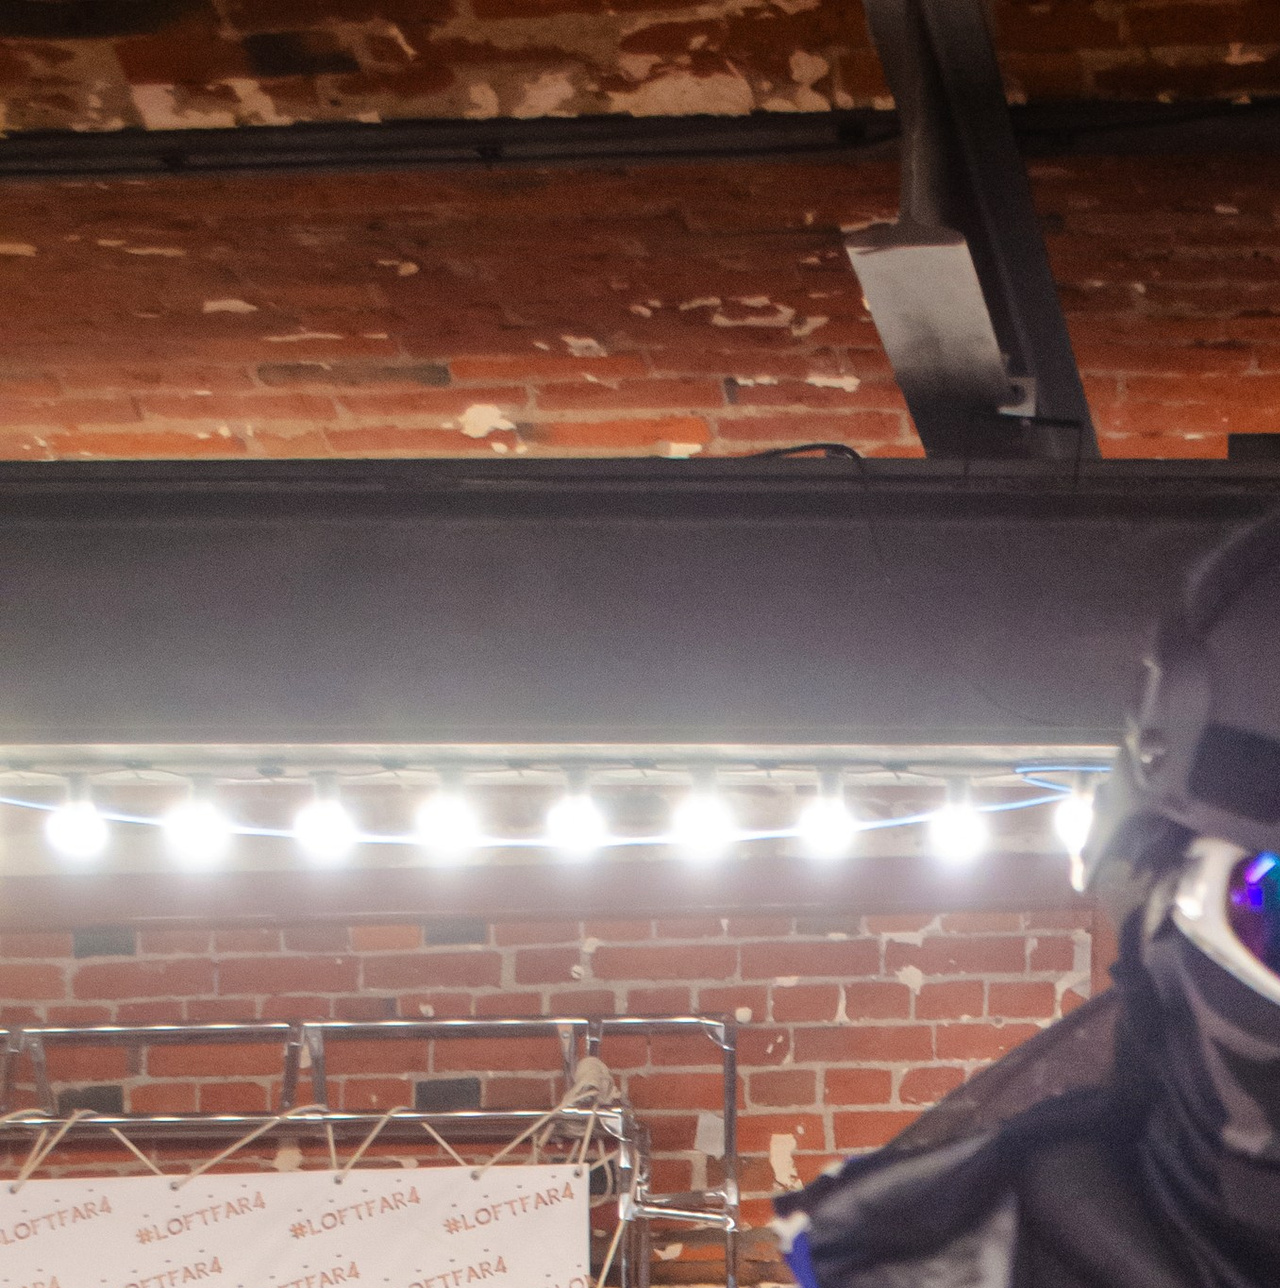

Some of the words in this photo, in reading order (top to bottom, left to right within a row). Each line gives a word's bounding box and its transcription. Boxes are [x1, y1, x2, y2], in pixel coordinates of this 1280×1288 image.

[136, 1192, 266, 1245] #LOFTFAR4
[290, 1187, 421, 1239] #LOFTFAR4
[444, 1182, 576, 1235] #LOFTFAR4
